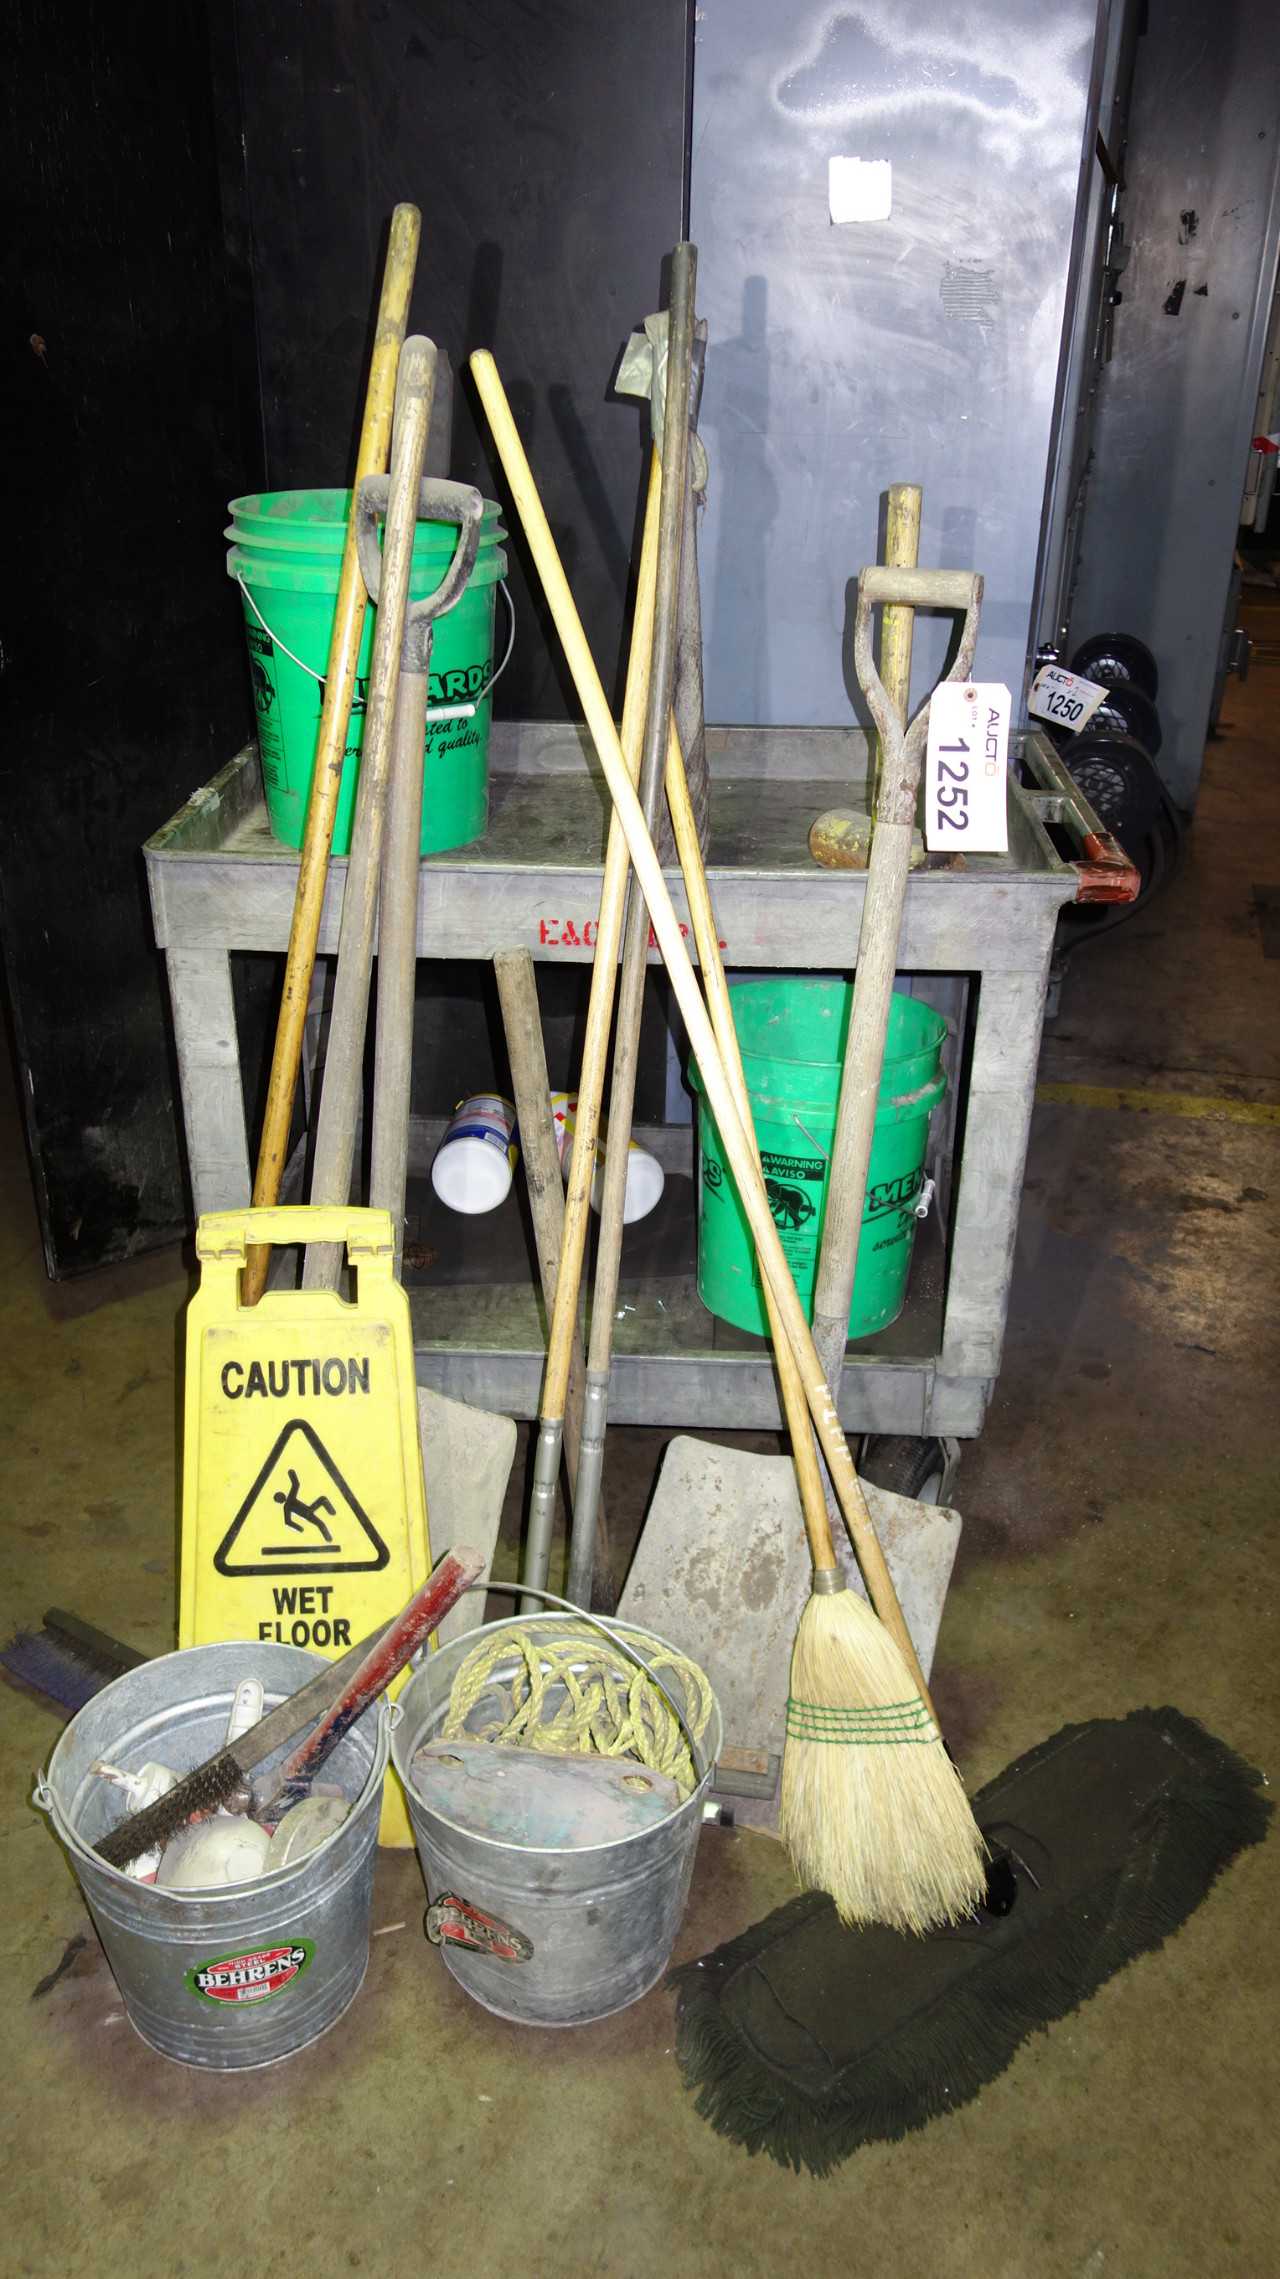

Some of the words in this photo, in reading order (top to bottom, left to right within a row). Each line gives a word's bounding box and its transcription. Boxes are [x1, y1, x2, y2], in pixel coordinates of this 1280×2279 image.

[1047, 691, 1084, 721] 1250
[457, 718, 468, 730] to
[438, 731, 480, 758] quality
[984, 708, 1000, 777] AUCTO
[936, 737, 971, 831] 1252
[770, 1156, 824, 1170] WARNING
[772, 1167, 806, 1180] AVISO
[220, 1356, 371, 1400] CAUTION
[272, 1585, 334, 1616] WET
[258, 1618, 352, 1648] FLOOR
[197, 1947, 305, 1988] BEHRENS
